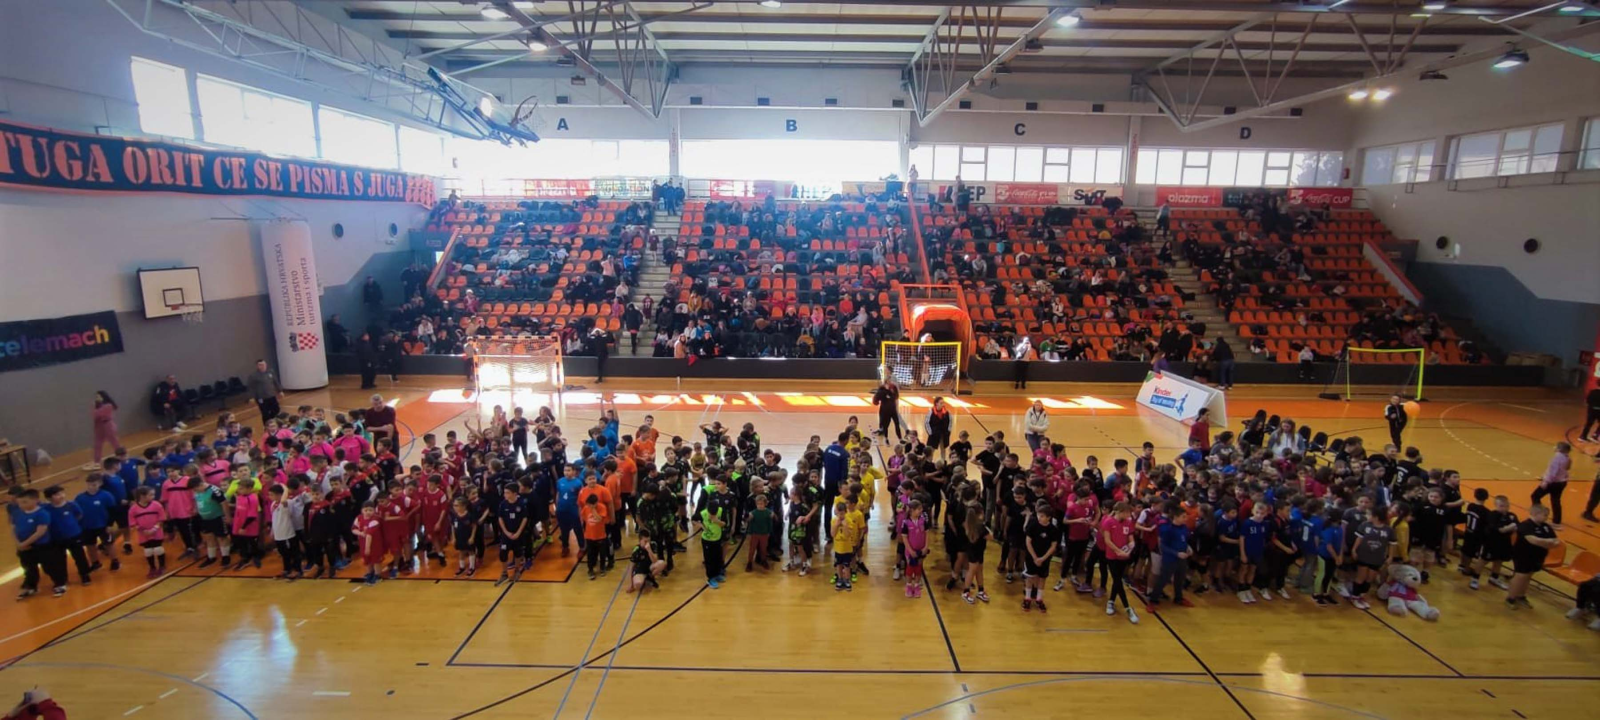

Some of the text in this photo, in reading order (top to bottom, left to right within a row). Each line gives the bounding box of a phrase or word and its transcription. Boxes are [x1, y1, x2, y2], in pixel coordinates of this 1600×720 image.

[557, 117, 569, 131] A
[785, 119, 798, 132] B
[1014, 123, 1026, 136] C
[1240, 127, 1252, 140] D
[122, 145, 205, 187] ORIT
[213, 156, 248, 190] CE
[253, 158, 284, 191] SE
[288, 162, 350, 196] PISMA
[353, 171, 364, 196] S
[368, 172, 404, 198] JUGA
[300, 258, 311, 284] sporta
[290, 270, 307, 326] Ministarstvo
[304, 292, 316, 324] turizma
